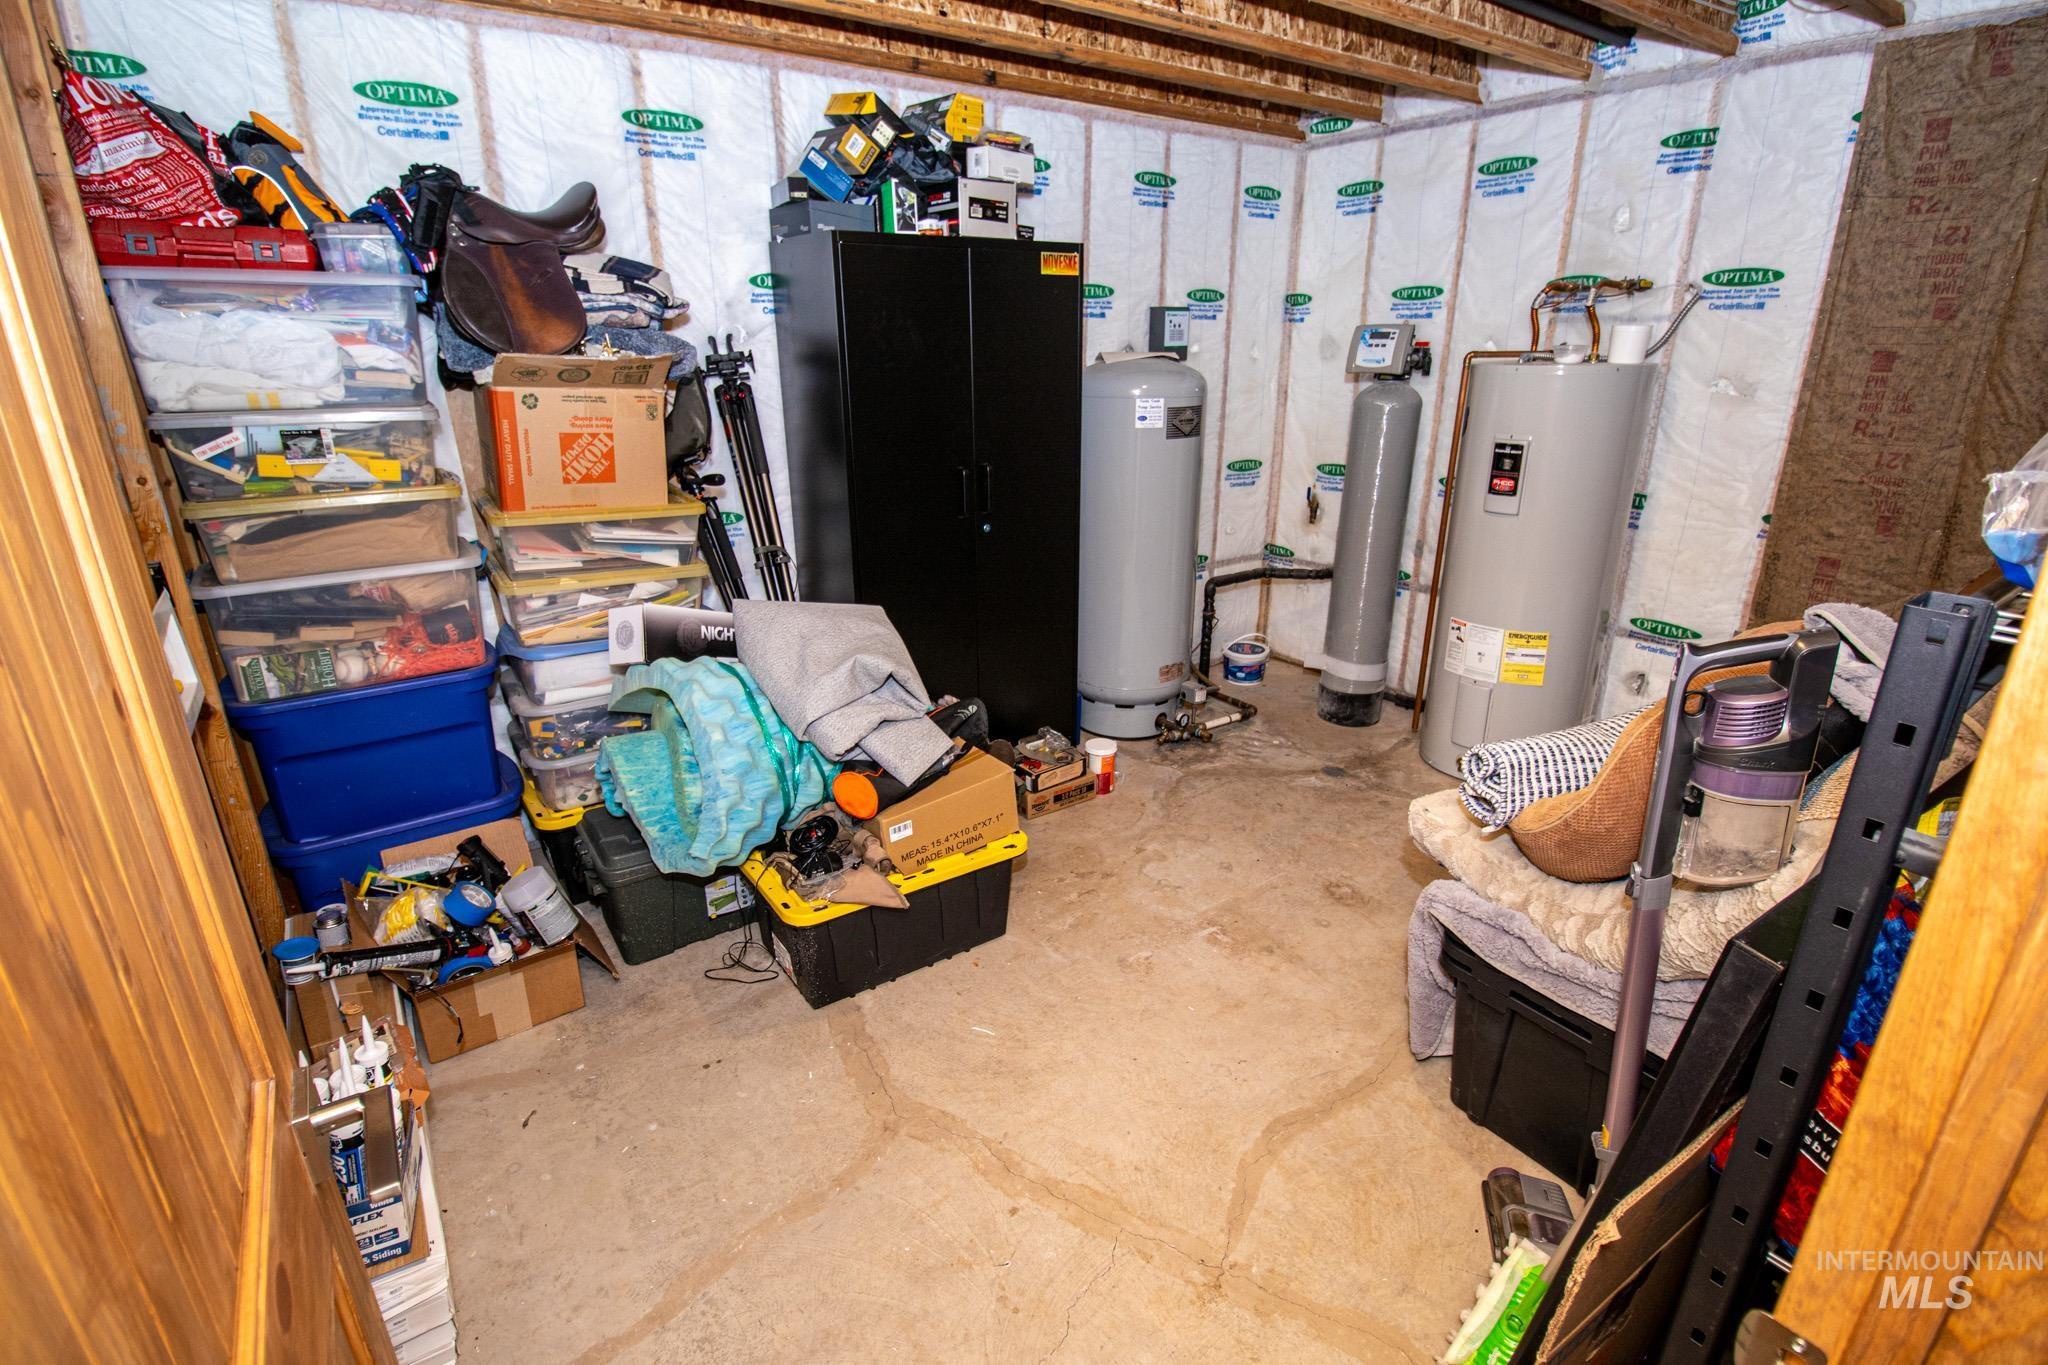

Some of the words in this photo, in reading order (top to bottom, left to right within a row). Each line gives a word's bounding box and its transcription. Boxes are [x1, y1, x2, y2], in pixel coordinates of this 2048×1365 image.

[71, 55, 134, 75] TIMA
[365, 82, 449, 105] OPTIMA
[630, 111, 697, 130] OPTIMA
[1668, 130, 1719, 146] OPTIM
[1483, 158, 1531, 173] OPTIMA
[81, 180, 122, 192] outlook
[121, 176, 137, 187] on
[133, 167, 154, 181] life
[1139, 172, 1172, 187] OPTIMA
[1342, 181, 1379, 196] OPTIMA
[1248, 186, 1279, 200] OPTIMA
[1711, 270, 1775, 284] OPTIMA
[1190, 290, 1222, 302] OPTIMA
[1397, 286, 1438, 300] OPTIMA
[502, 419, 510, 442] HEAVY
[504, 443, 512, 461] DUTY
[561, 432, 593, 466] DEPOT
[562, 432, 614, 484] HOME
[507, 462, 515, 485] SMALL
[591, 457, 610, 479] THE
[1230, 460, 1260, 471] OPTIMA
[1636, 618, 1693, 639] OPTIMA
[254, 659, 266, 689] TOLKIEN
[318, 648, 337, 689] HOBBIT
[901, 845, 930, 862] MEAS:
[917, 852, 944, 867] MADE
[945, 846, 955, 854] IN
[956, 833, 984, 850] CHINA
[372, 1246, 402, 1263] Siding
